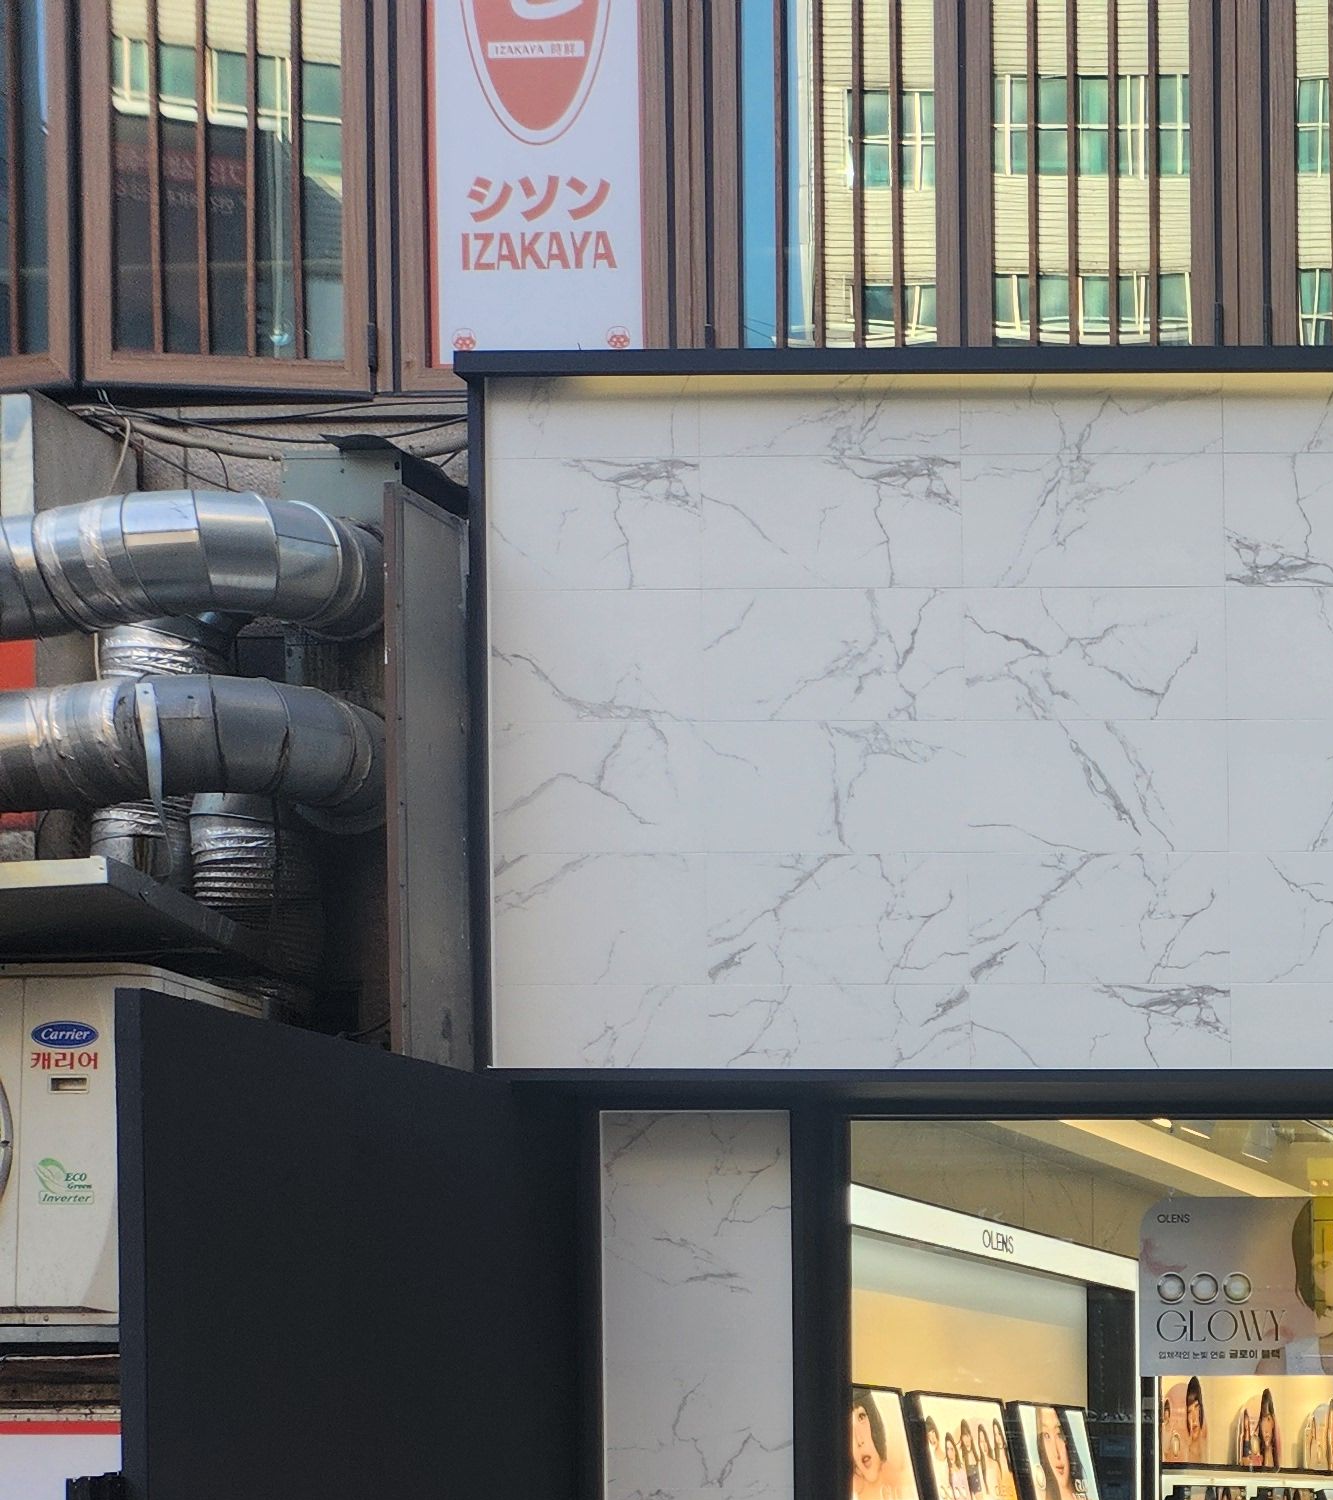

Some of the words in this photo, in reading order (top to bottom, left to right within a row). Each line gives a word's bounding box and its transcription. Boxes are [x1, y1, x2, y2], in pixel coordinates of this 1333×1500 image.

[494, 44, 544, 56] IZAKAYA
[466, 174, 612, 223] シソン
[460, 230, 618, 272] IZAKAYA
[41, 1026, 91, 1042] Carrier
[30, 1051, 99, 1070] 캐리어
[64, 1172, 88, 1183] ECO
[66, 1182, 93, 1190] Green
[41, 1192, 92, 1204] Inverter
[1157, 1214, 1191, 1224] OLENS
[982, 1229, 1015, 1256] OLENS
[1156, 1310, 1287, 1342] GLOWY
